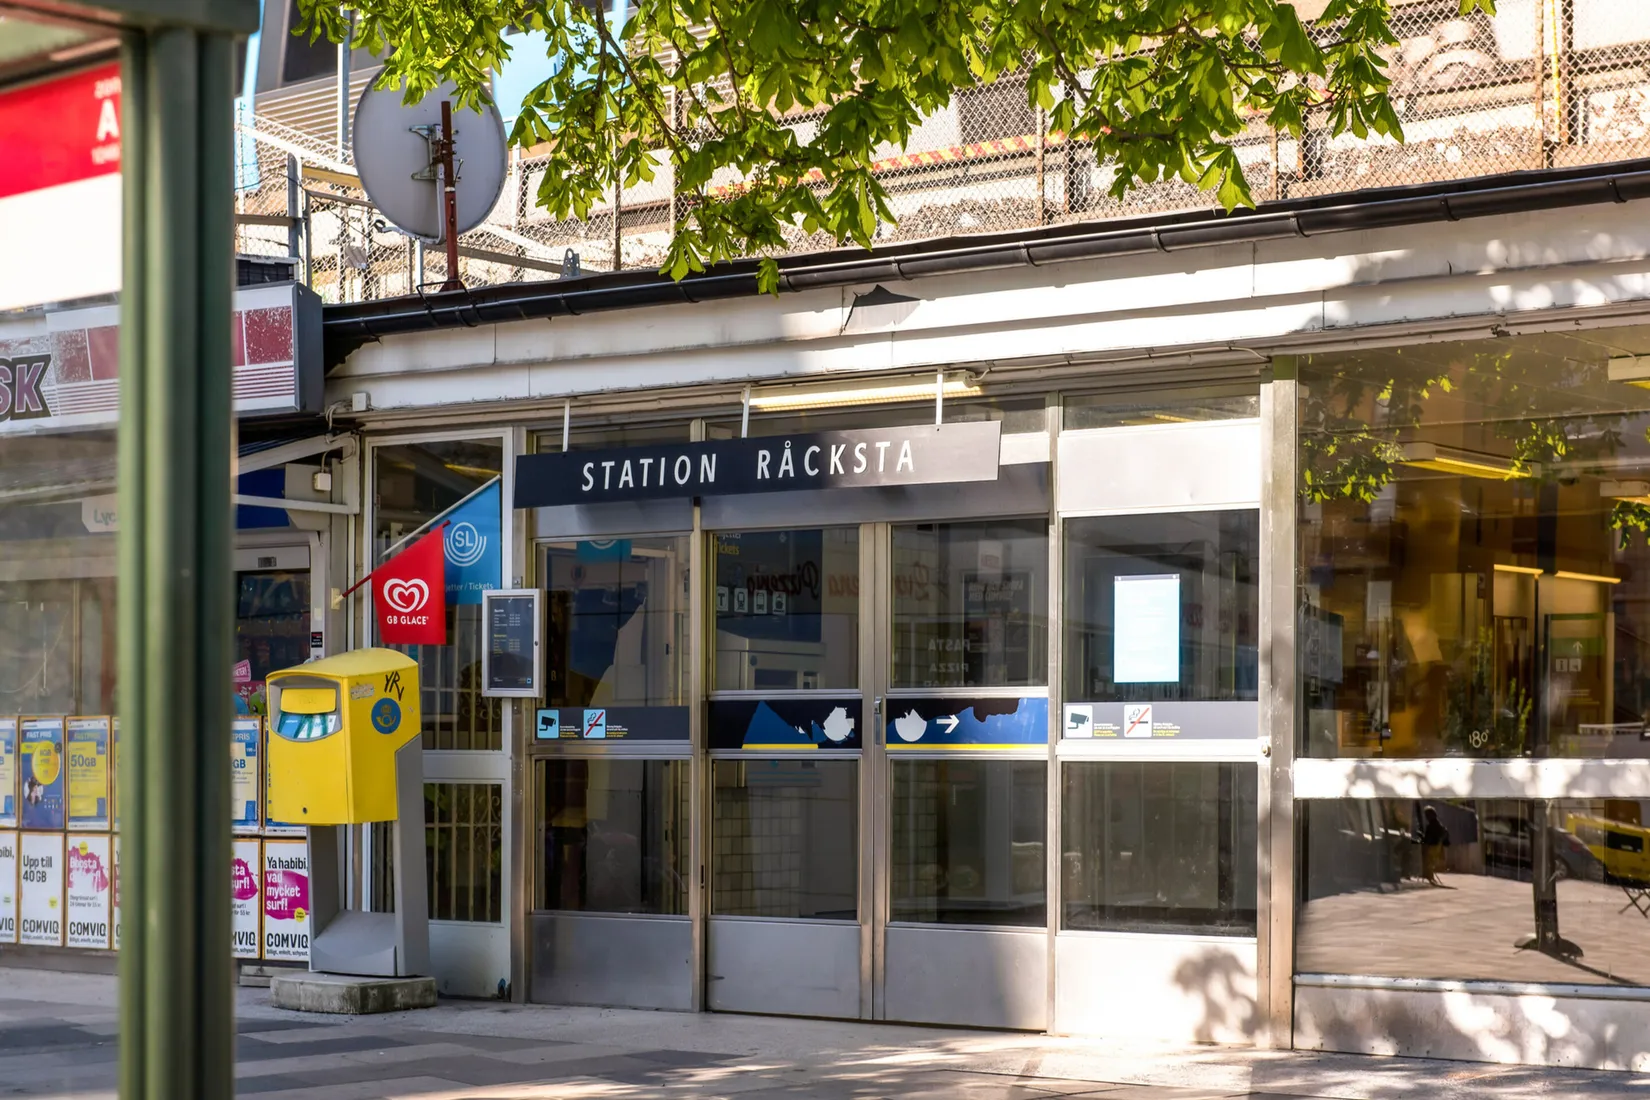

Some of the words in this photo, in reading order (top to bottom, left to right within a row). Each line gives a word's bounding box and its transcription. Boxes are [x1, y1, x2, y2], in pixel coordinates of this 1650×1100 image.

[581, 453, 717, 492] STATION
[757, 439, 916, 480] RÅCKSTA
[455, 530, 474, 548] SL
[468, 582, 494, 591] Tickets
[386, 615, 398, 625] GB
[23, 856, 39, 870] Upp
[41, 856, 53, 868] till
[267, 856, 278, 869] Ya
[266, 871, 283, 883] vad
[266, 885, 301, 899] mycket
[266, 898, 288, 911] surf!
[22, 919, 60, 934] COMVIQ
[69, 922, 106, 936] COMVIQ
[266, 933, 309, 948] COMVIQ
